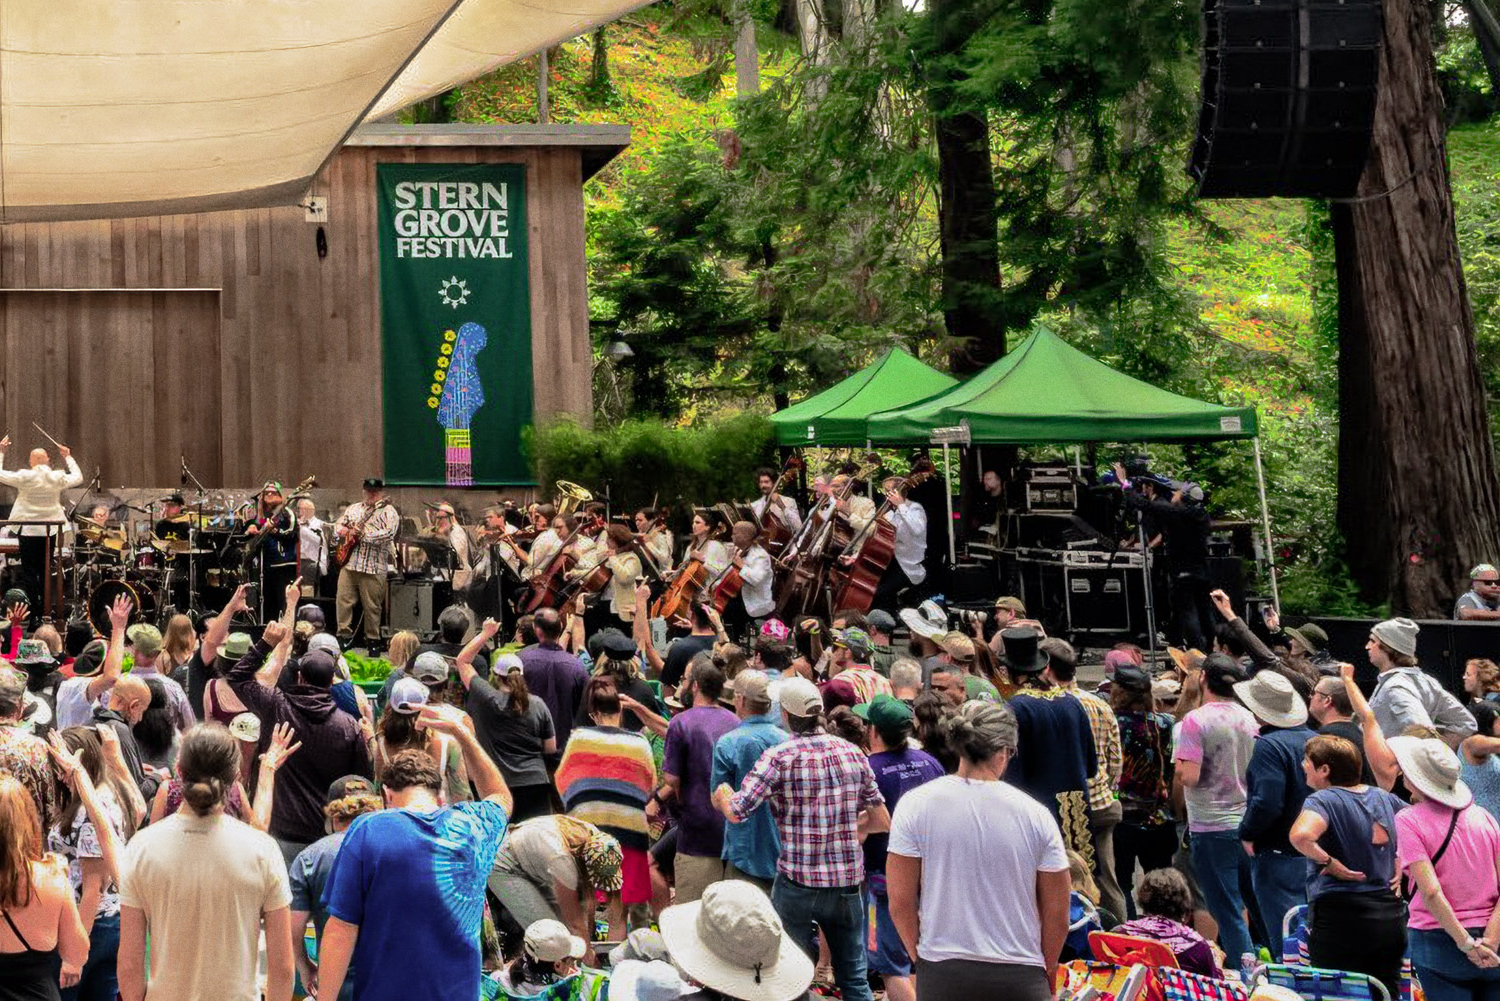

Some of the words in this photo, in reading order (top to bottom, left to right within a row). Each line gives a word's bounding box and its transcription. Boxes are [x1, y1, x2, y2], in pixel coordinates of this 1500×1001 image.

[395, 181, 507, 209] STERN
[394, 209, 509, 237] GROVE
[396, 237, 513, 258] FESTIVAL
